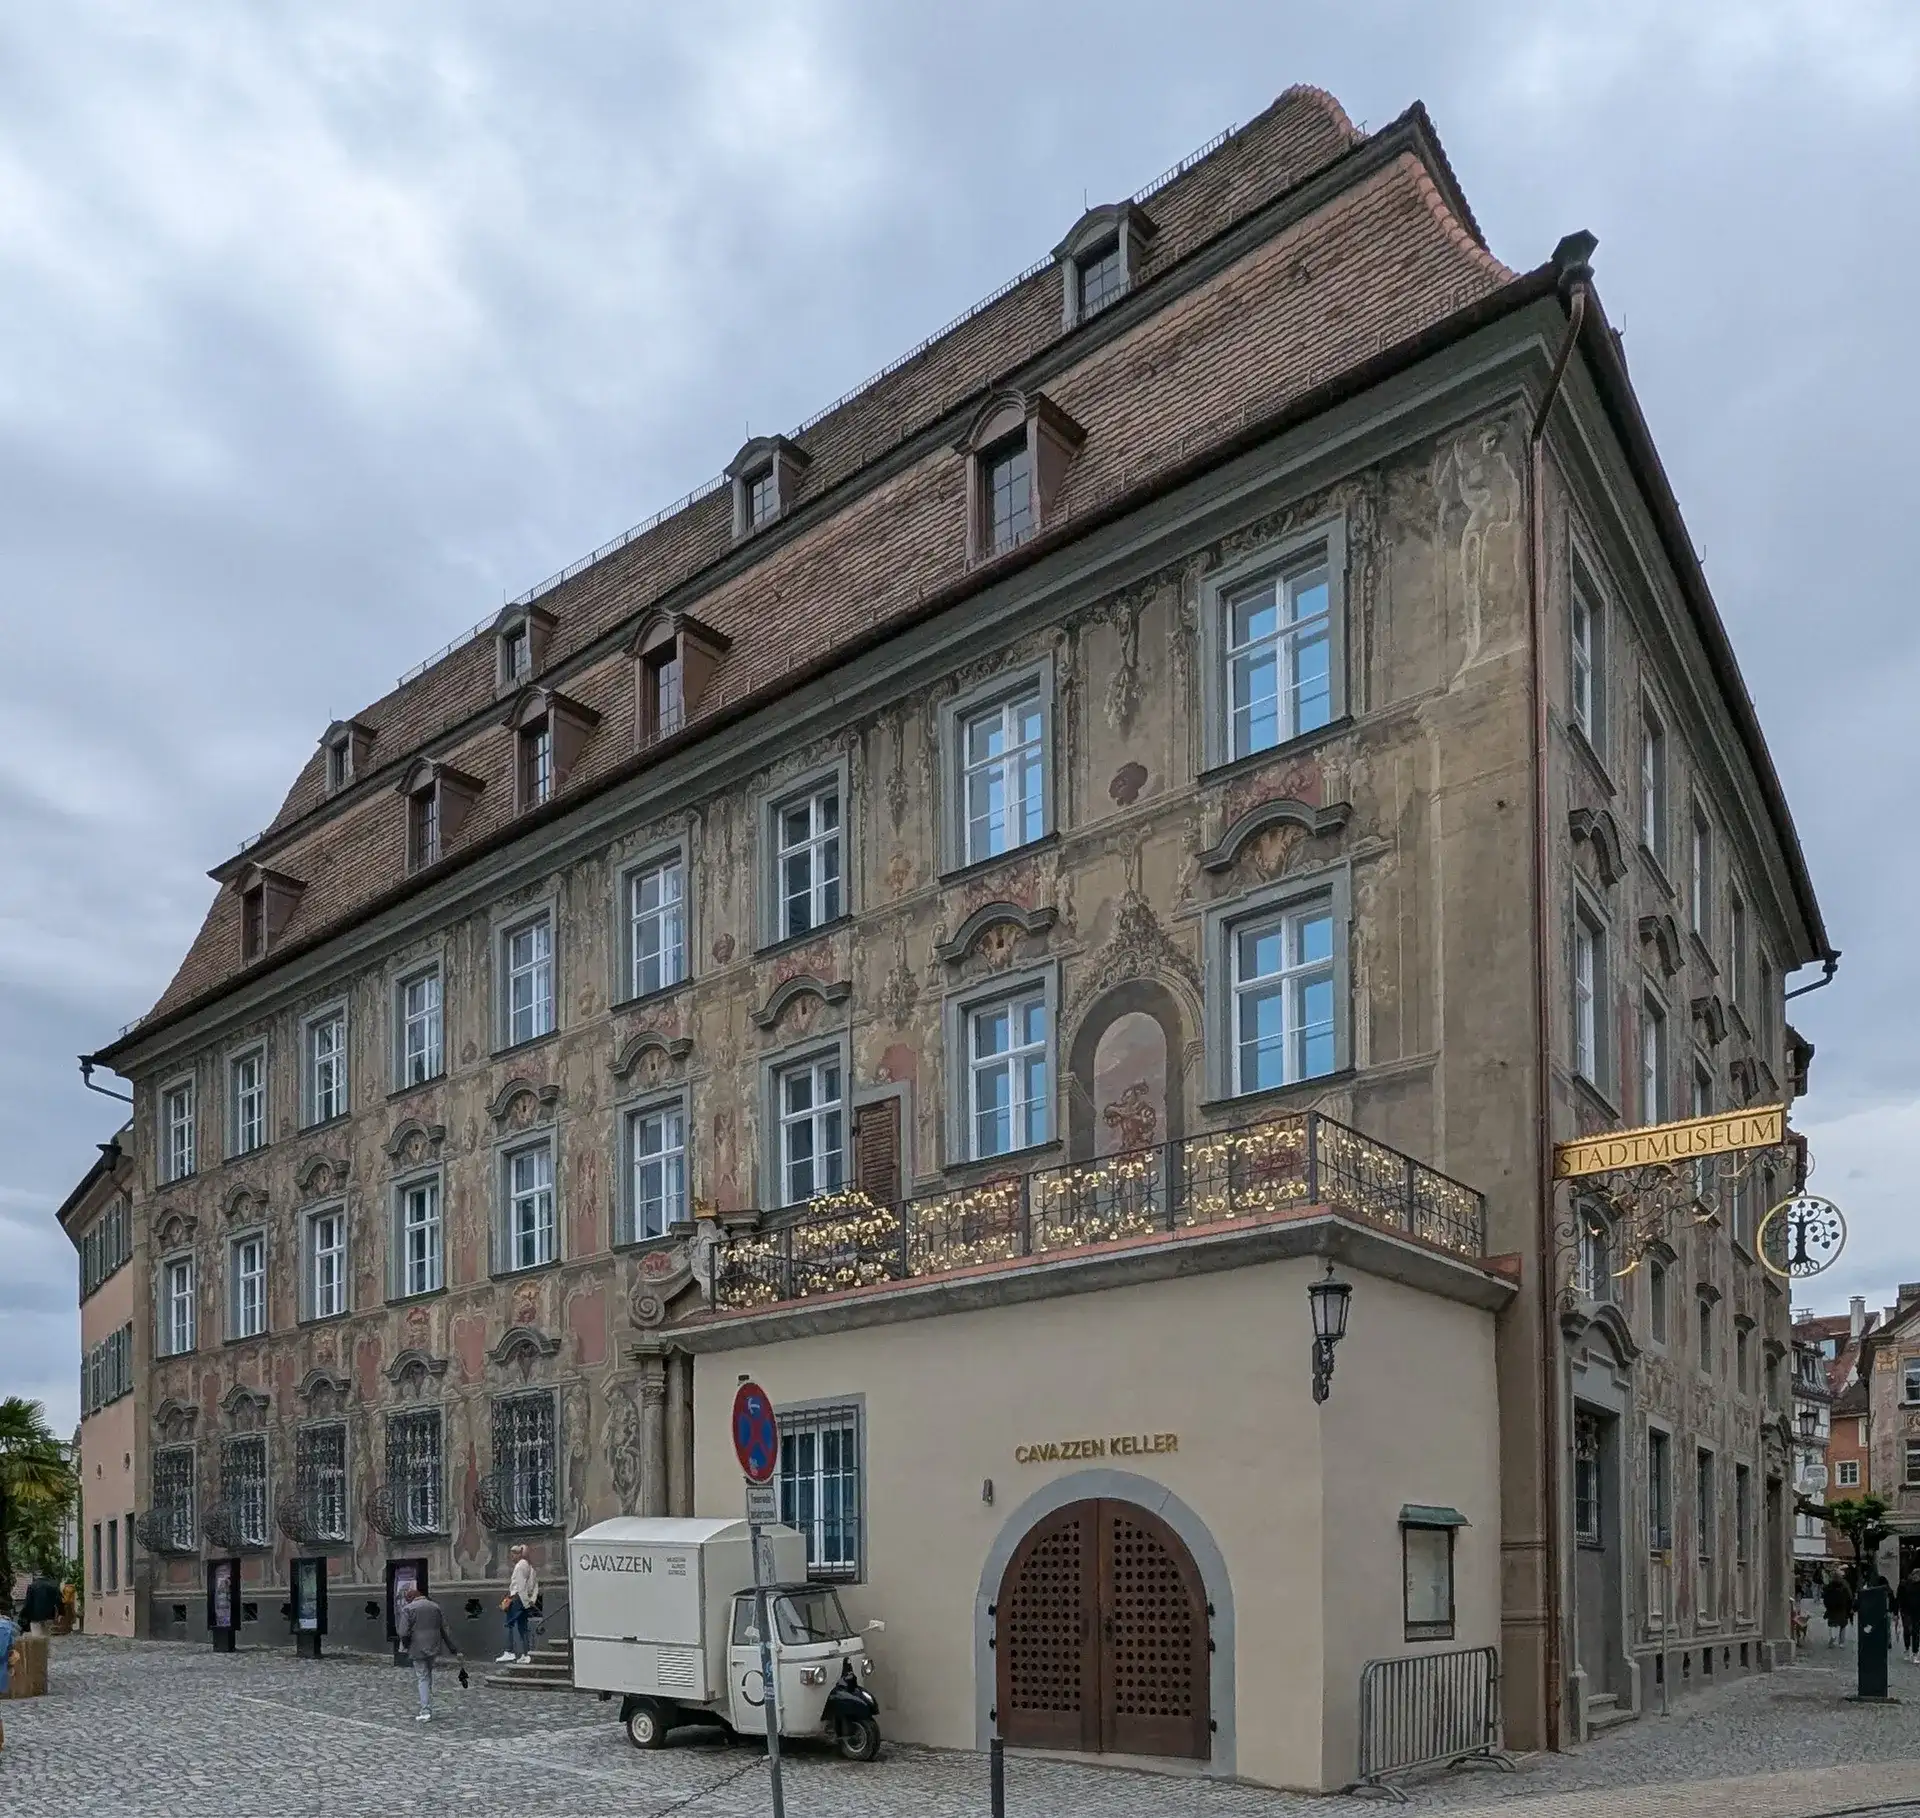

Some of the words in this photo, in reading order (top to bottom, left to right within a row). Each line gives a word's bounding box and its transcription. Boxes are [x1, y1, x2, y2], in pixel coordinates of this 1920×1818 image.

[1558, 1116, 1776, 1175] STADTMUSEUM
[1015, 1438, 1105, 1464] CAVAZZEN
[1110, 1433, 1179, 1457] KELLER
[579, 1553, 653, 1574] CAVAZZEN
